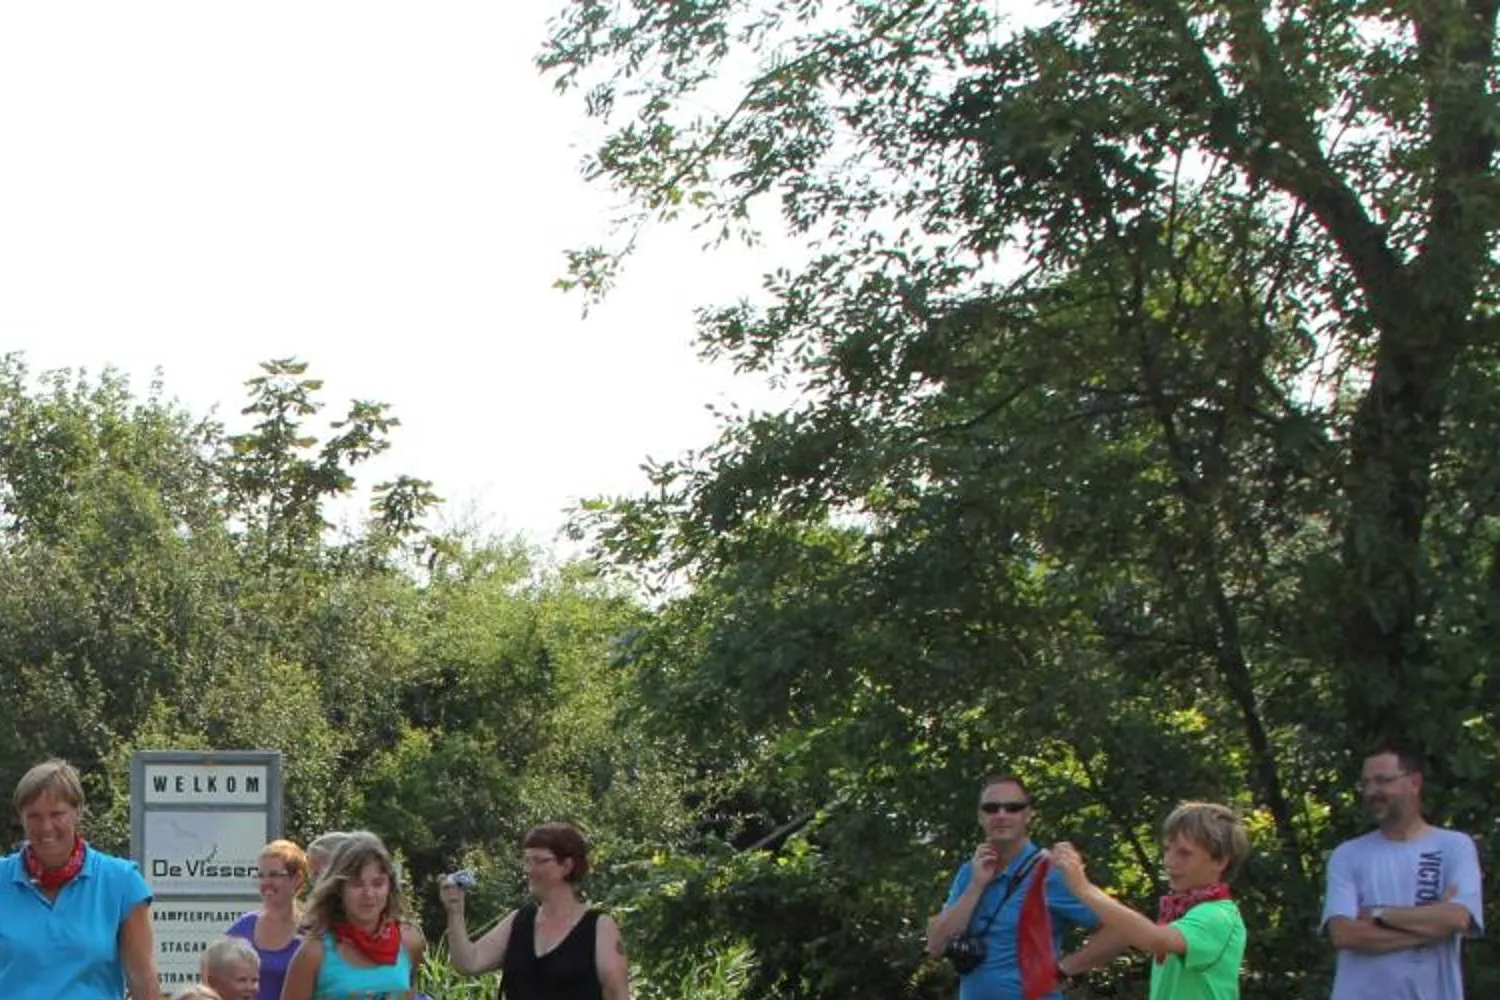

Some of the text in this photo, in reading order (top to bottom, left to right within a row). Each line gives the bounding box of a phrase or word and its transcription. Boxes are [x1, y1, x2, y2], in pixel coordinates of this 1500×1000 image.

[153, 775, 259, 793] WELKOM
[153, 859, 259, 877] De Visser
[1414, 850, 1444, 907] VICTO
